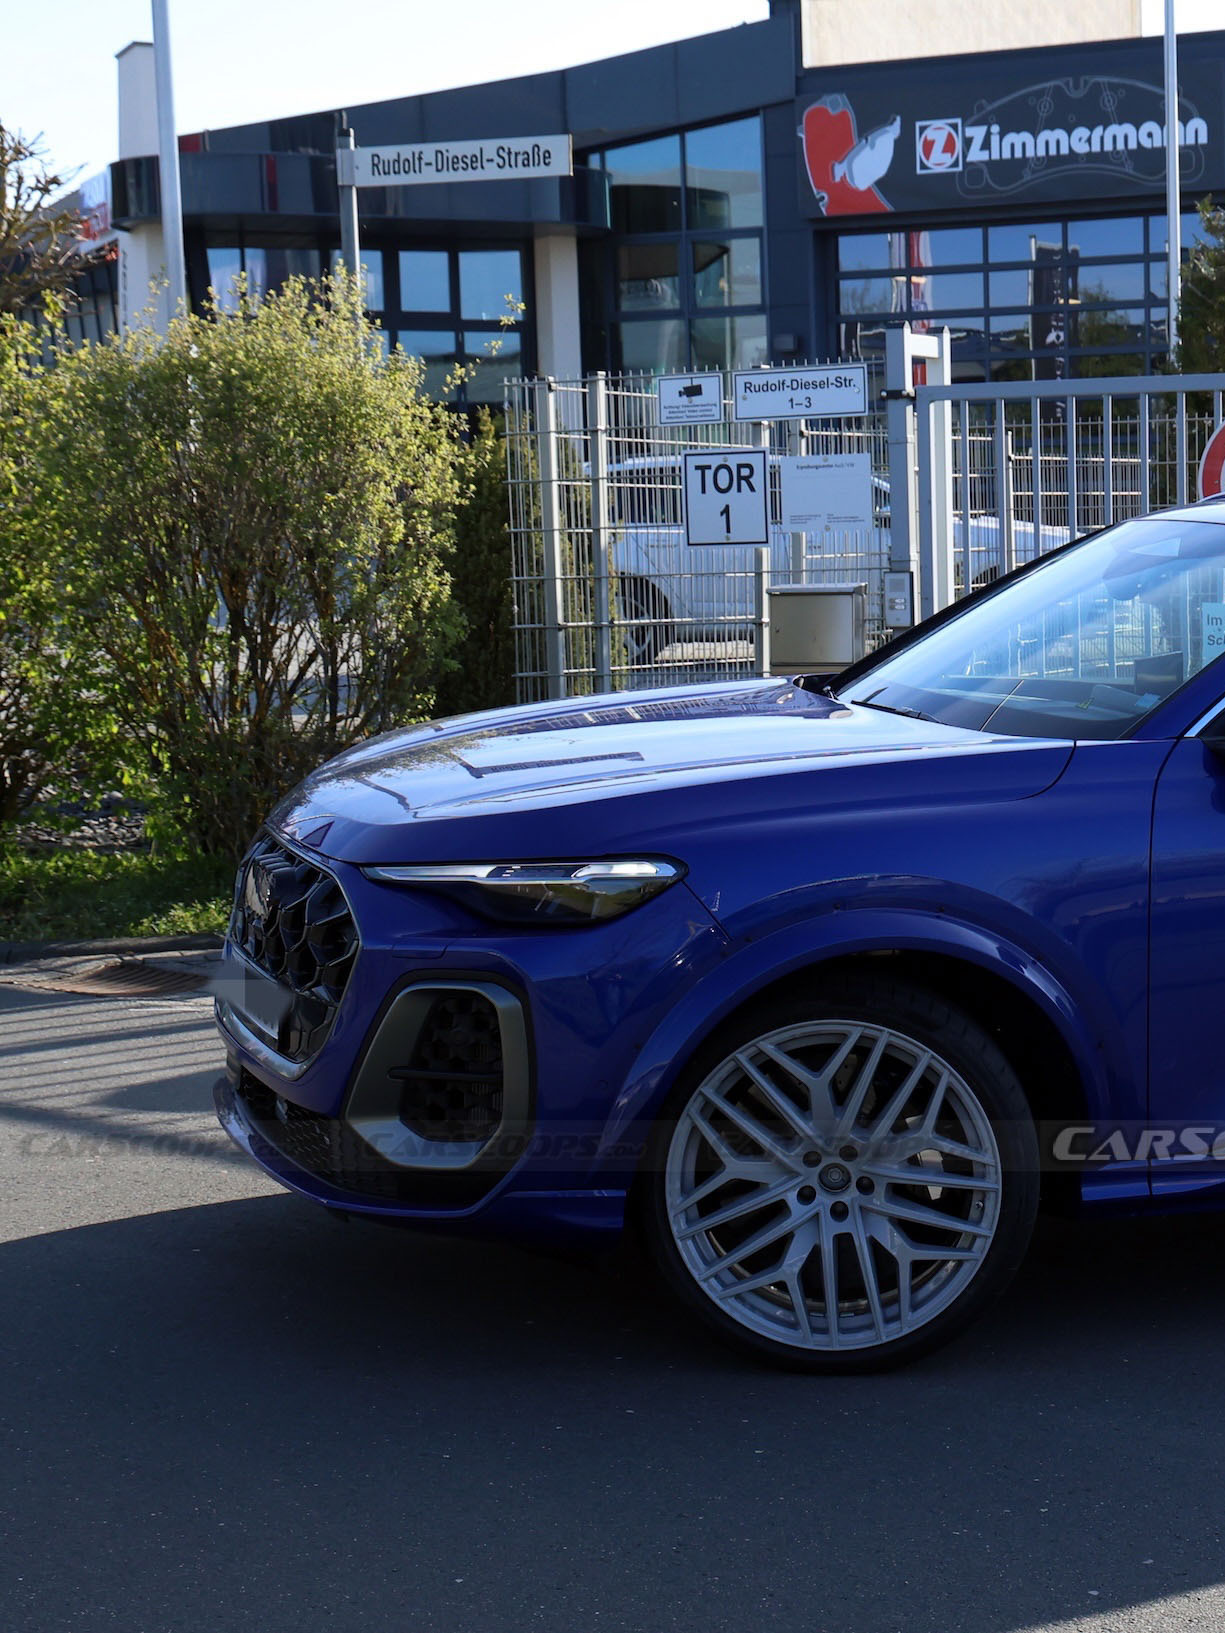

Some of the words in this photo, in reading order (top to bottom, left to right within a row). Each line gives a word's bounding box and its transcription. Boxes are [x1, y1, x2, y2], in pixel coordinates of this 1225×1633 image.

[371, 143, 552, 177] Rudolf-Diesel-Straße
[743, 375, 857, 394] Rudolf-Diesel-Str.
[694, 462, 756, 494] TOR
[719, 504, 731, 534] 1
[1206, 614, 1223, 626] Im
